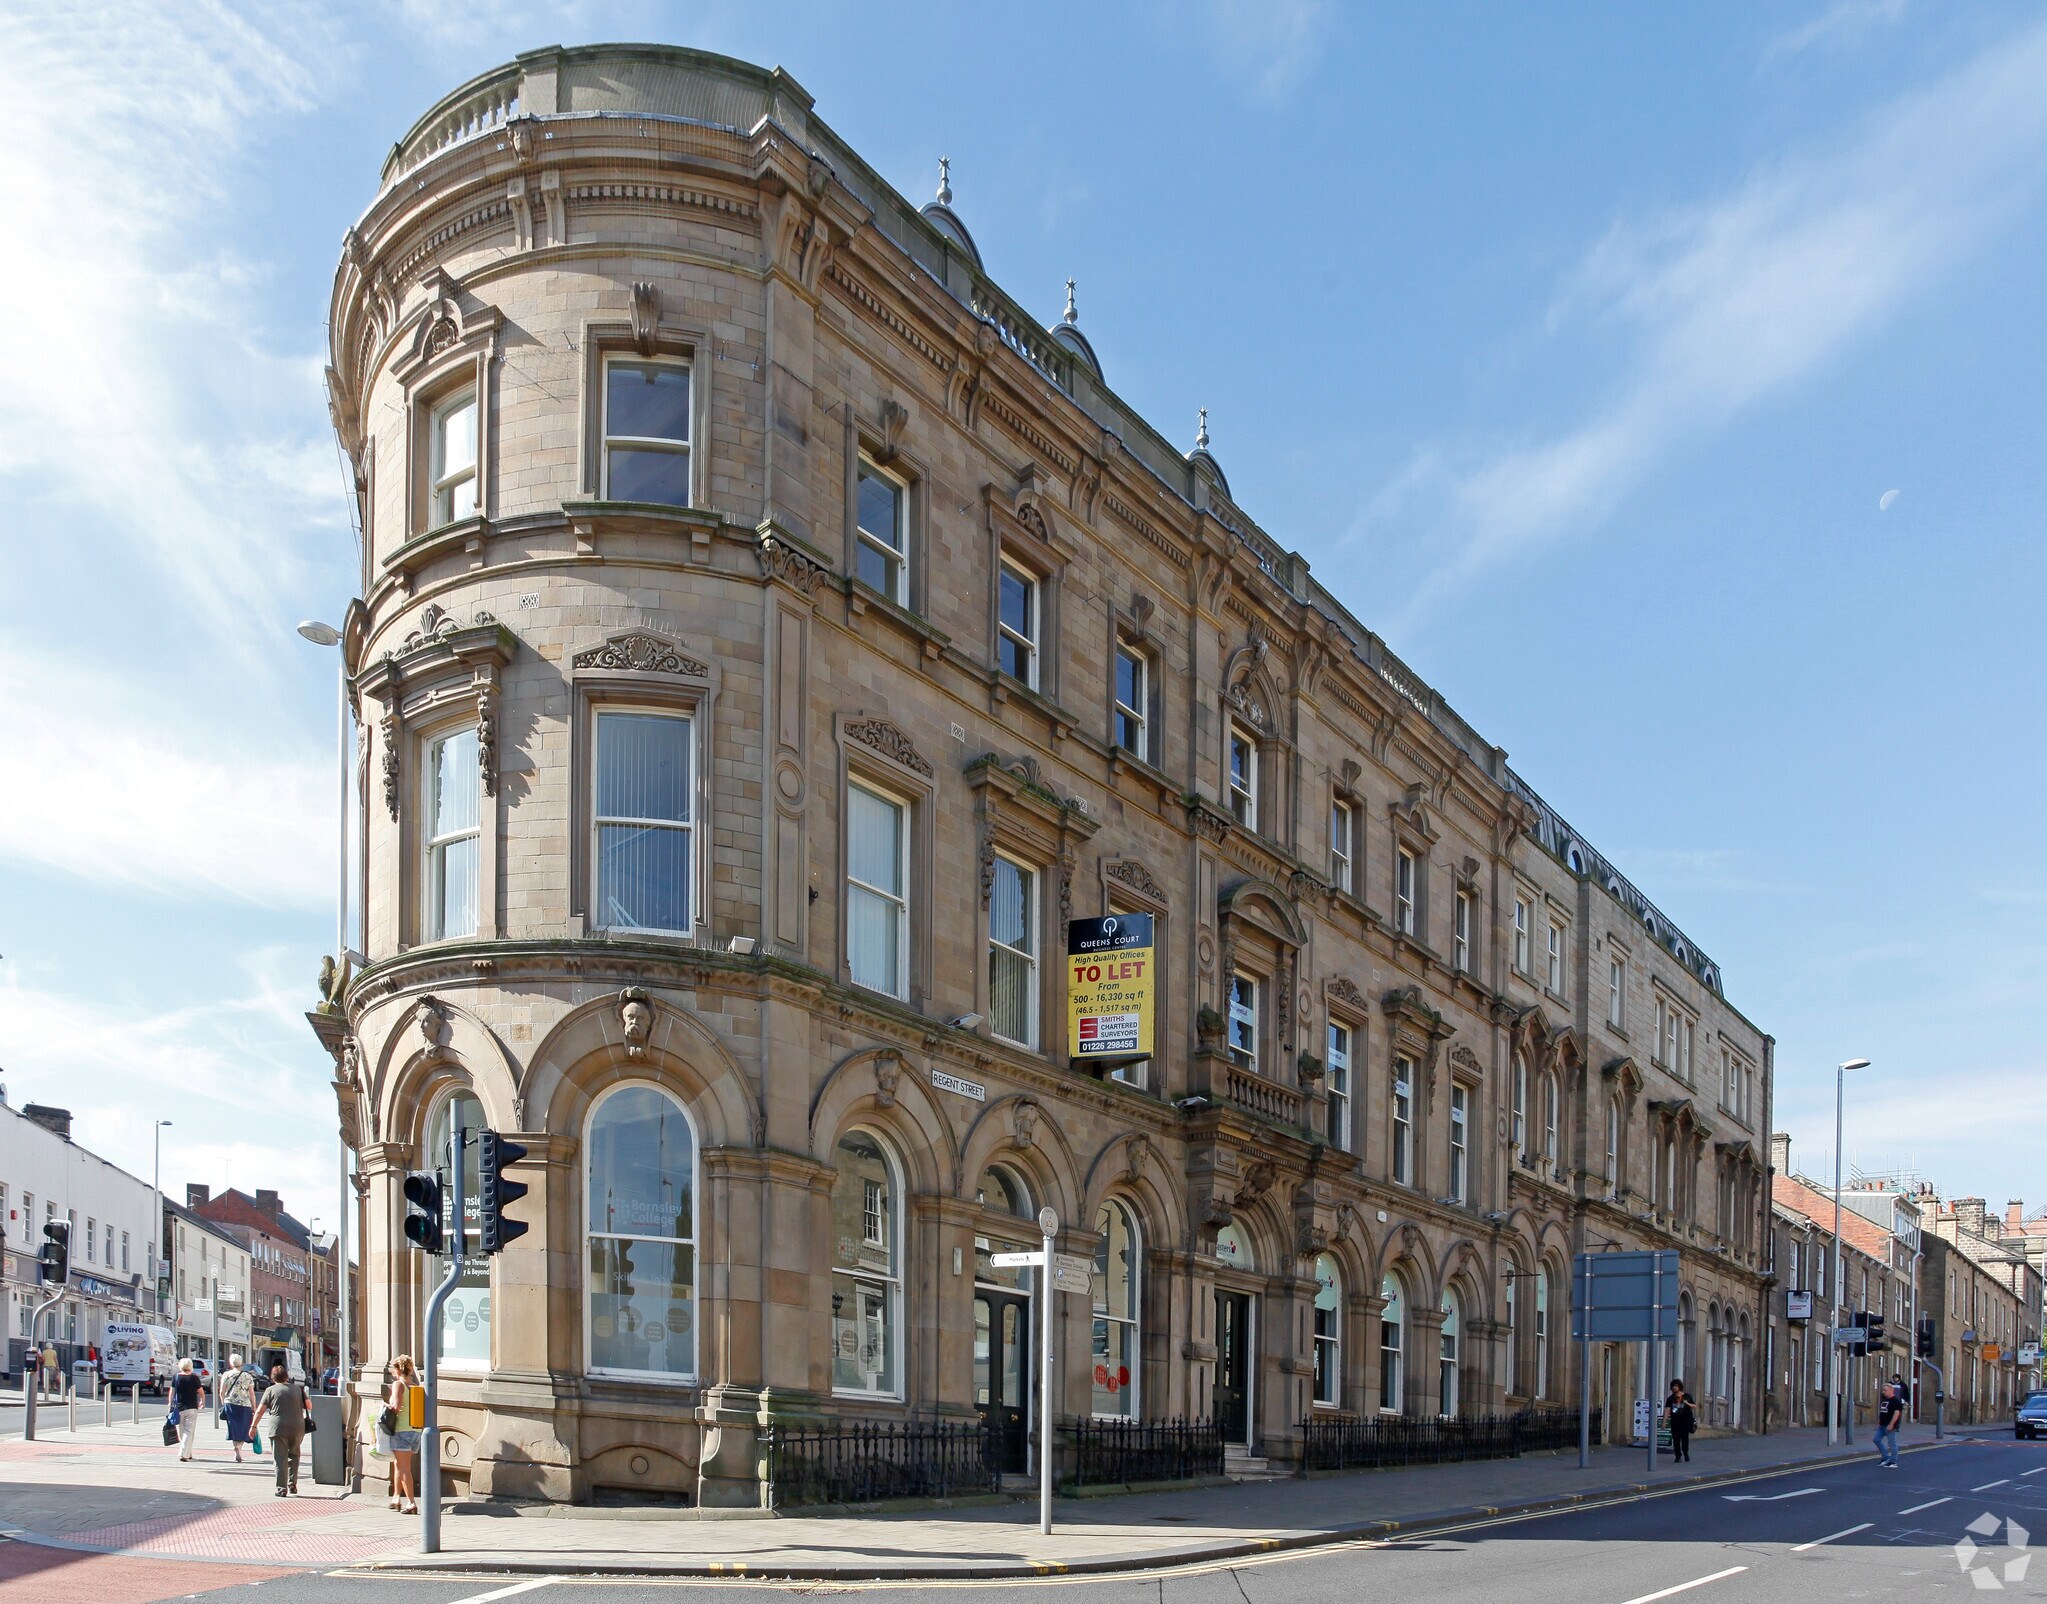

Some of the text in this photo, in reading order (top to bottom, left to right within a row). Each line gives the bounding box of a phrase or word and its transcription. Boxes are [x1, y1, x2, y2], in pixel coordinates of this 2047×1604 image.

[1080, 935, 1140, 948] QUEENS COURT
[1075, 951, 1145, 965] High Quality Offices
[1074, 961, 1146, 983] TO LET
[1098, 982, 1120, 991] From
[1073, 995, 1089, 1004] 500
[1096, 992, 1123, 1003] 16,330
[1124, 992, 1135, 1001] sq
[1137, 990, 1144, 999] ft
[1075, 1006, 1093, 1015] (46.5
[1100, 1004, 1119, 1013] 1,517
[1131, 1003, 1142, 1011] m)
[1100, 1015, 1125, 1023] SMITHS
[1100, 1022, 1138, 1030] CHARTERED
[1100, 1029, 1138, 1038] SURVEYORS
[1082, 1040, 1134, 1051] 01226 298456
[933, 1073, 984, 1097] REGENT STREET
[631, 1199, 682, 1217] Barnsley
[631, 1211, 675, 1228] College
[471, 1268, 490, 1277] Beyond
